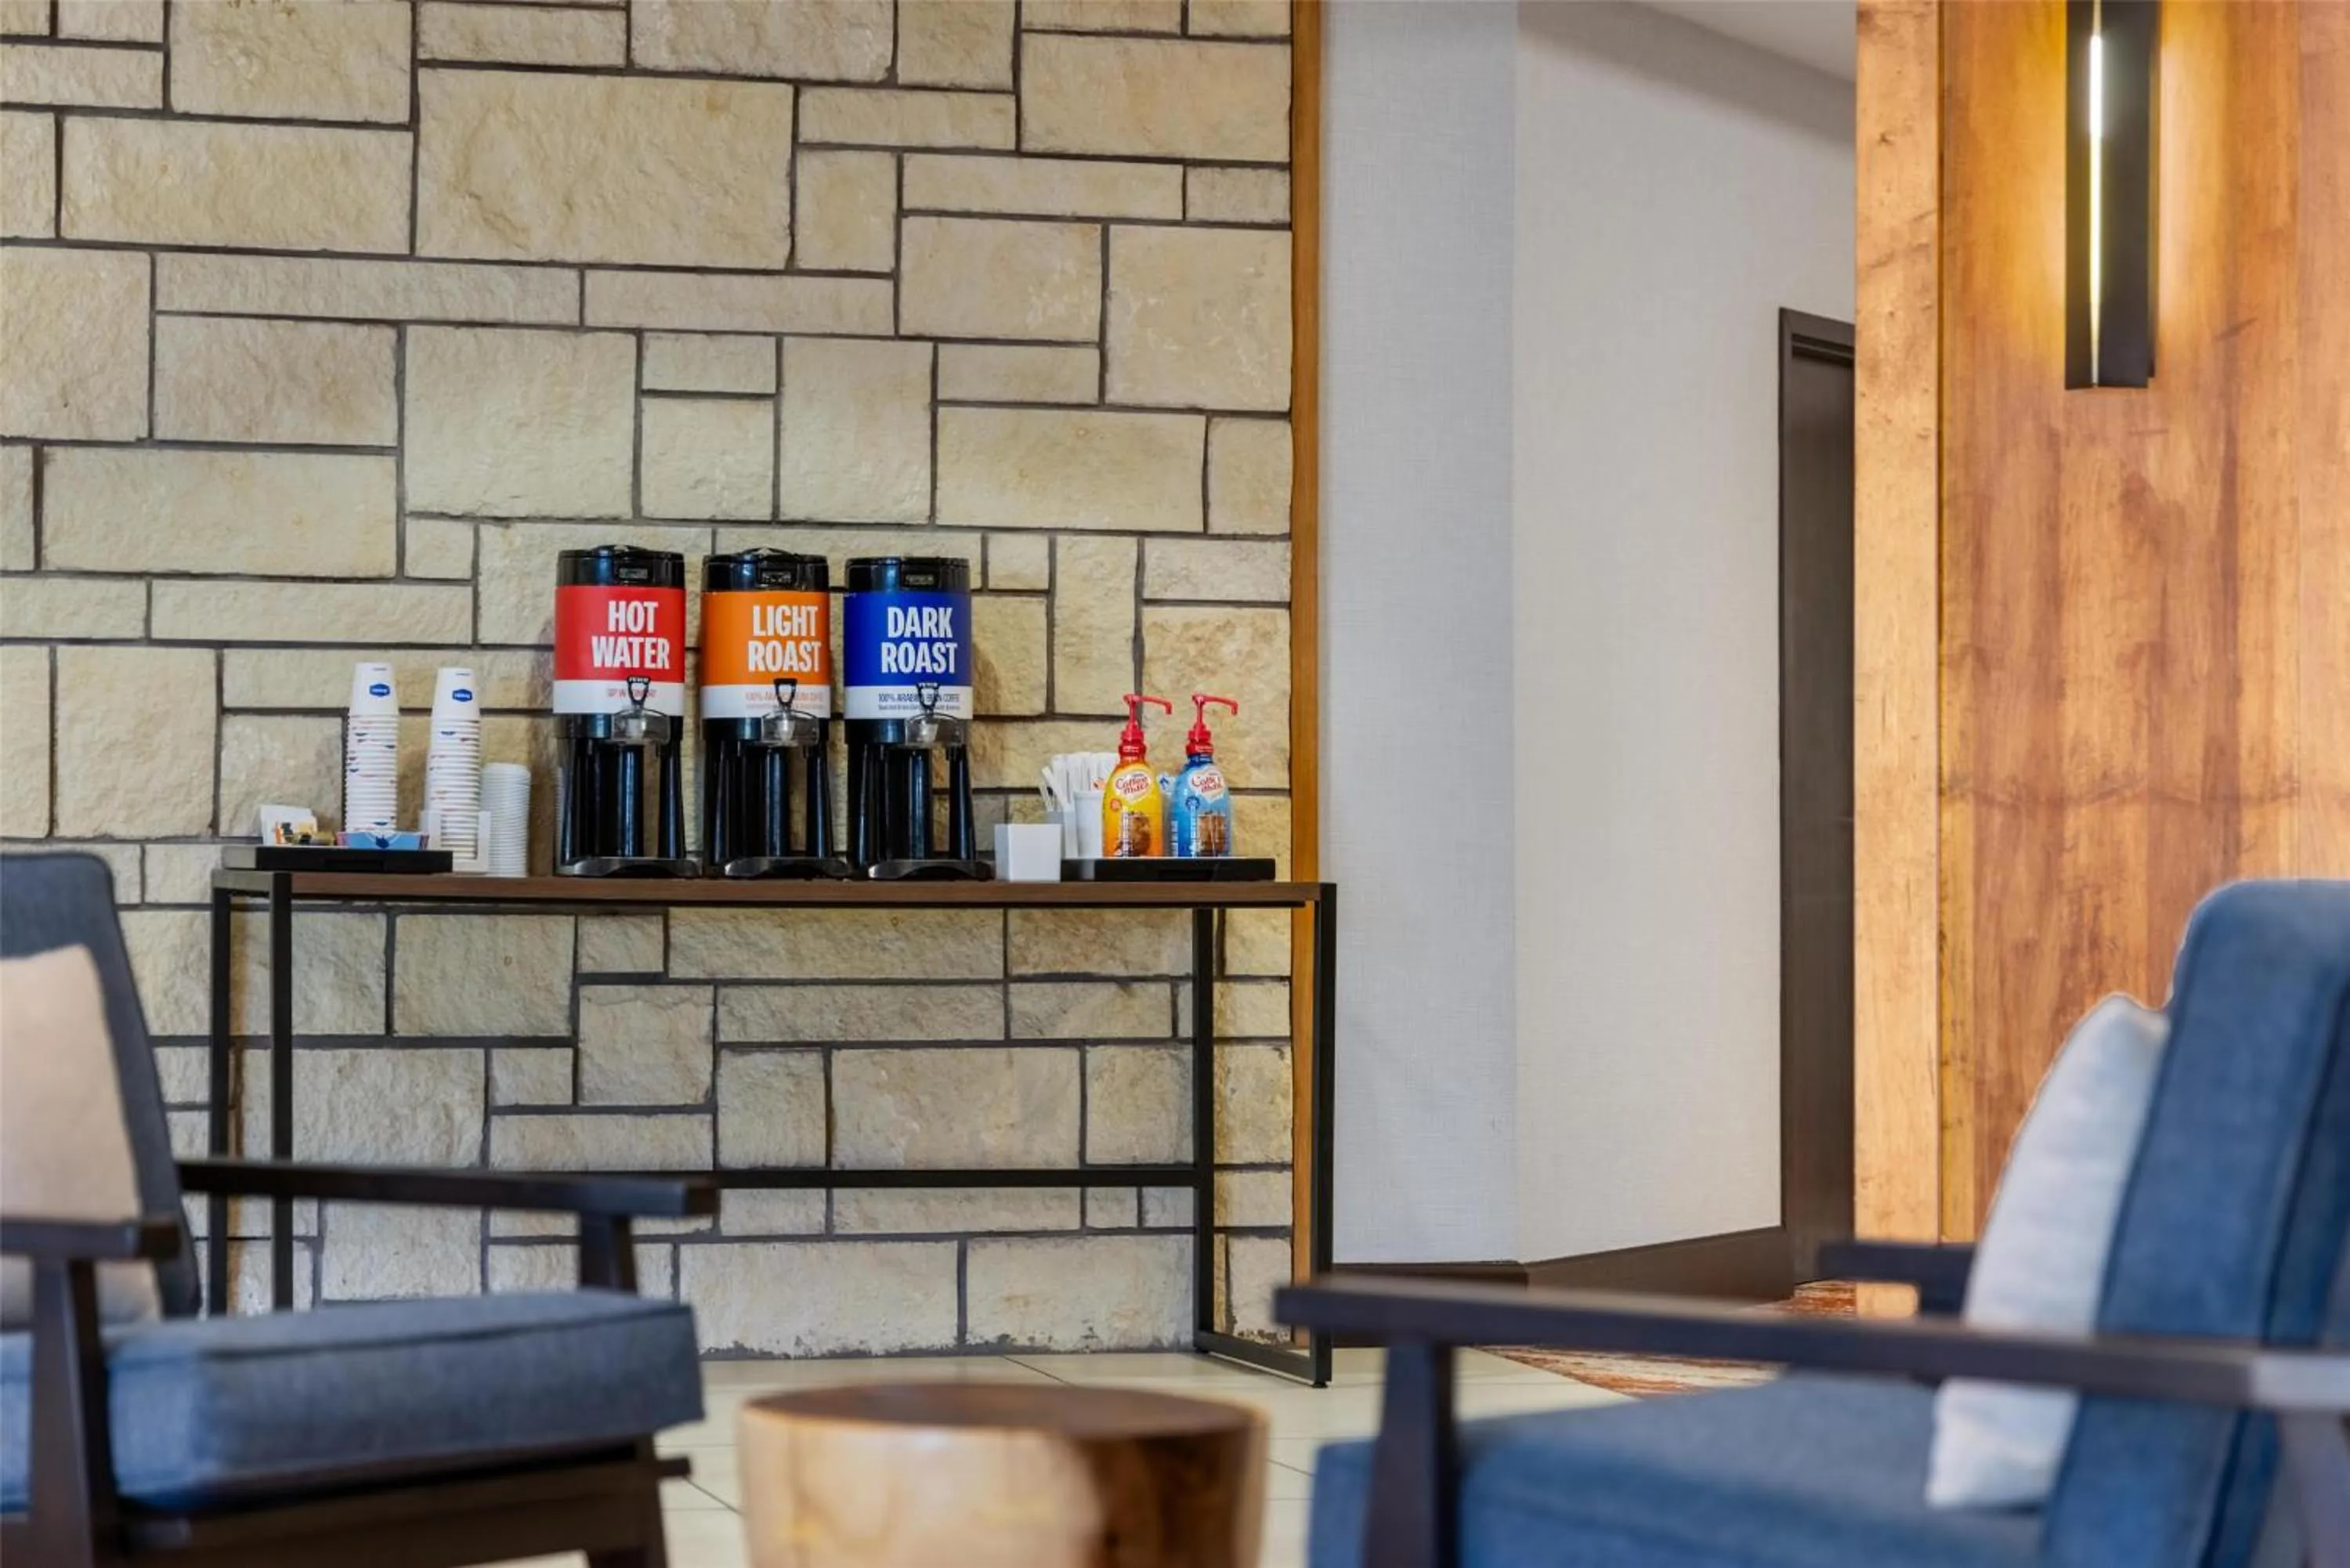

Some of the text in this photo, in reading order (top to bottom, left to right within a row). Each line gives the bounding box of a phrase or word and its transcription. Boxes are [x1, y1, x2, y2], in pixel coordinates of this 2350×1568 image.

[608, 600, 659, 634] HOT
[753, 605, 818, 637] LIGHT
[888, 606, 953, 638] DARK
[591, 635, 670, 670] WATER
[748, 640, 822, 673] ROAST
[881, 641, 958, 674] ROAST
